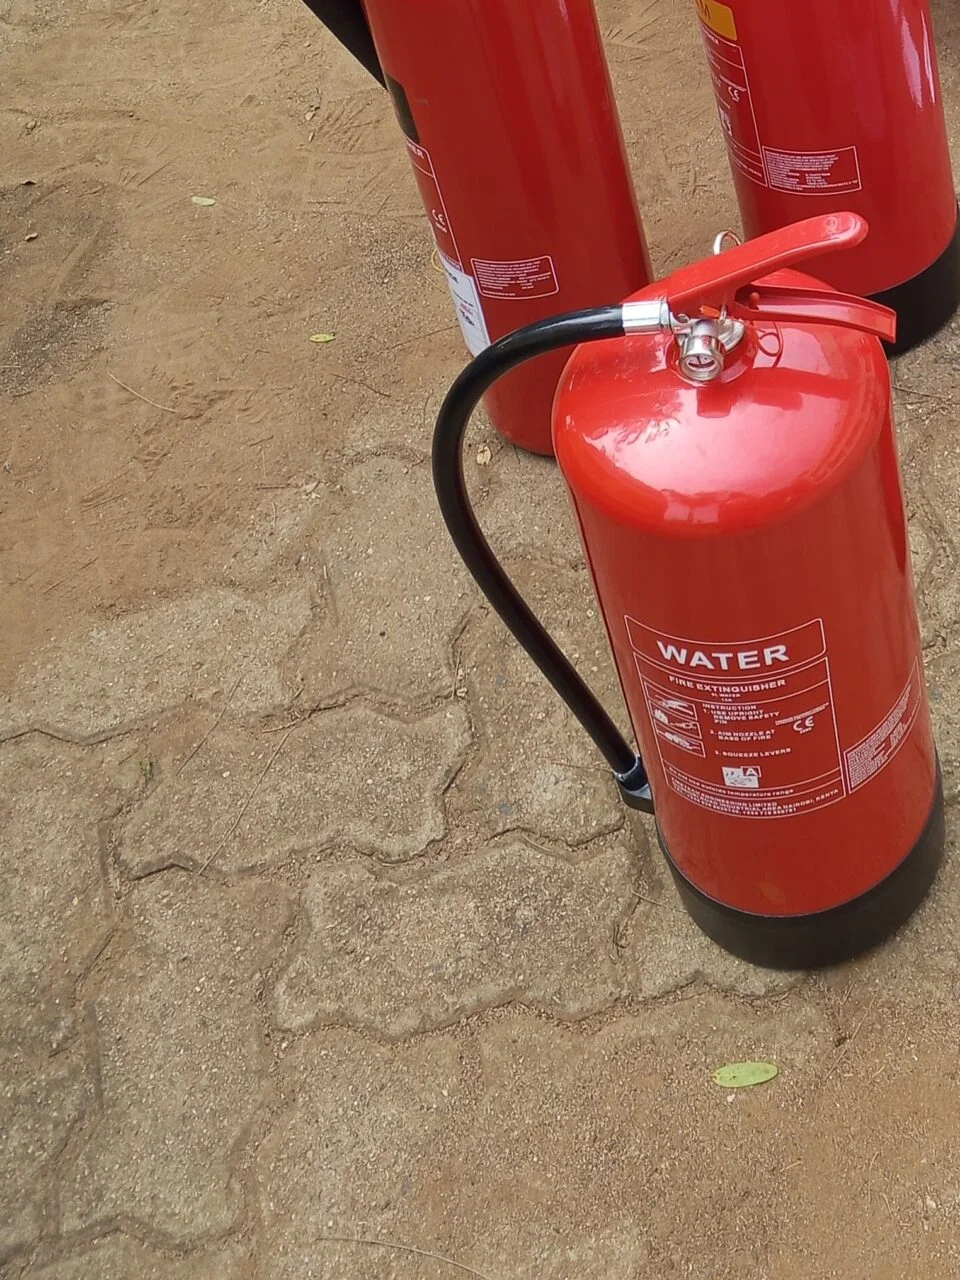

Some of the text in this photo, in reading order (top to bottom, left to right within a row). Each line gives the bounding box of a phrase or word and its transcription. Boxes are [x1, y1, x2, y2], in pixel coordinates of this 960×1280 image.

[656, 640, 789, 671] WATER
[668, 675, 786, 693] FIRE EXTINGUISHER
[728, 709, 764, 717] UPRIGHT
[740, 711, 780, 720] SAFETY
[760, 747, 792, 757] LEVERS
[727, 790, 772, 798] temperature
[773, 787, 794, 796] range
[815, 788, 839, 801] KENYA
